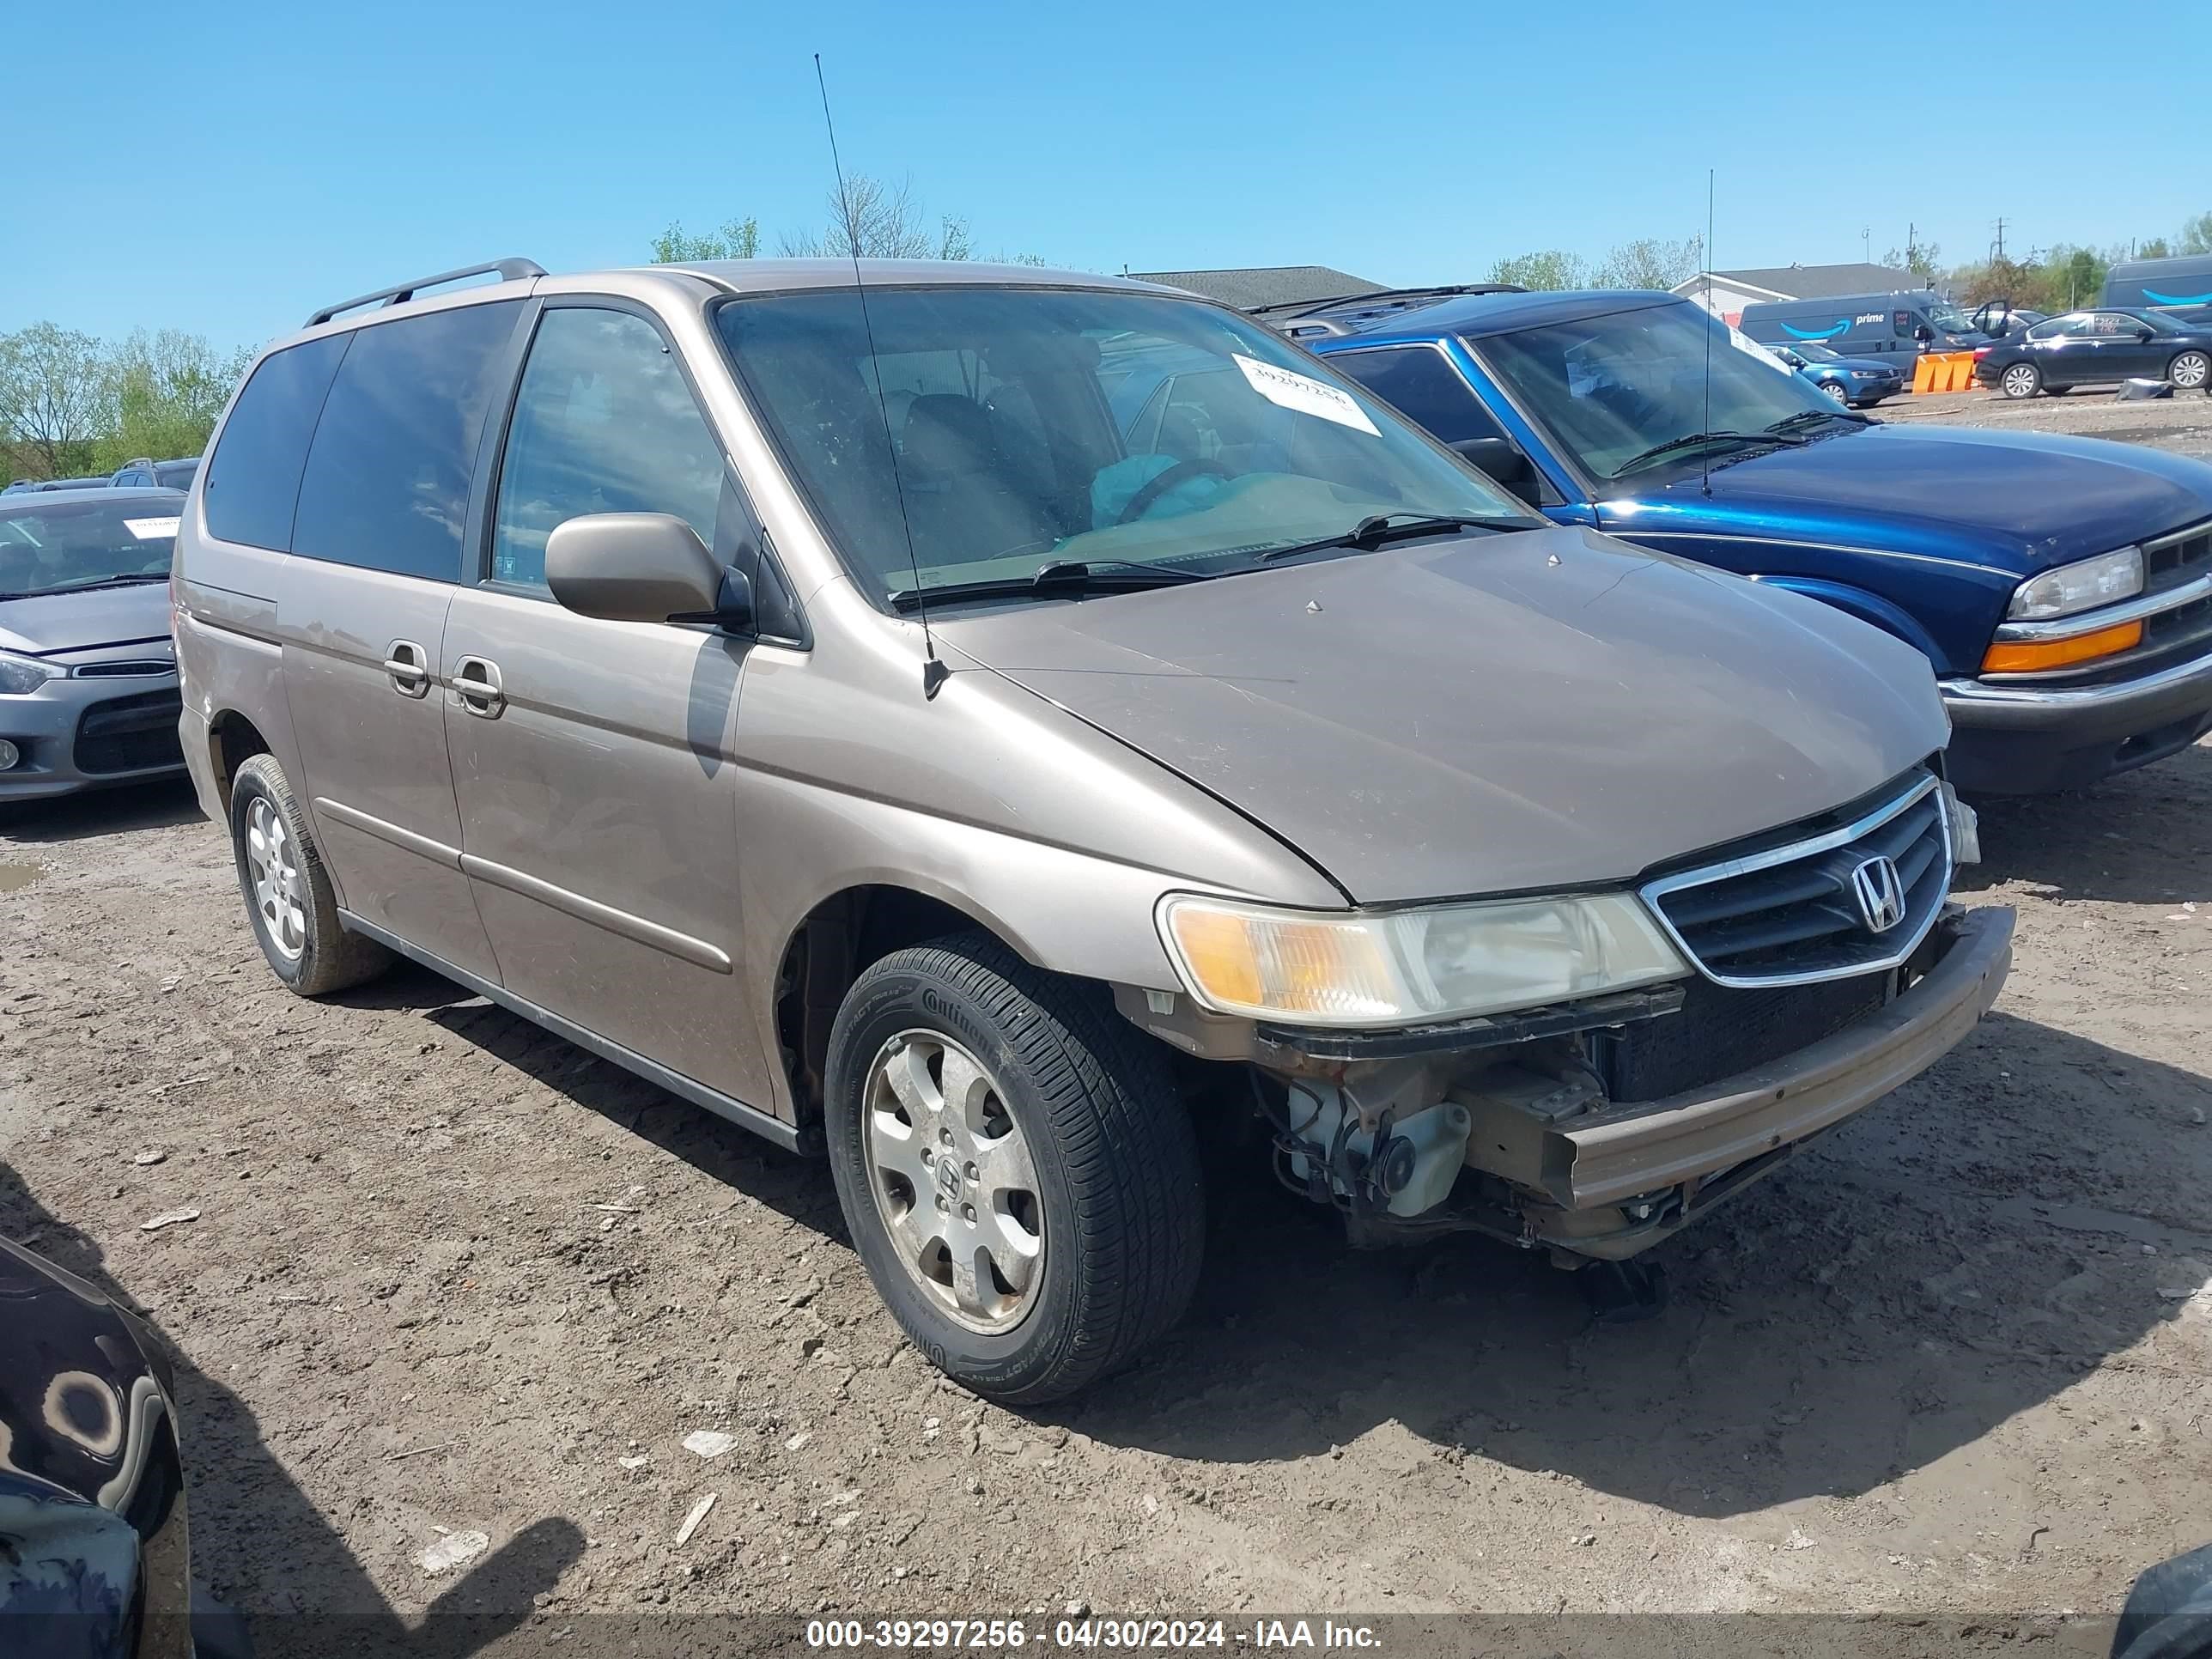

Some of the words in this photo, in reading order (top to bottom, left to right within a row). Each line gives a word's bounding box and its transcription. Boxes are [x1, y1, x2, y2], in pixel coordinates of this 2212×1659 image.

[1856, 313, 1885, 326] prime
[1251, 367, 1347, 405] 39297256
[922, 988, 1004, 1067] Continent
